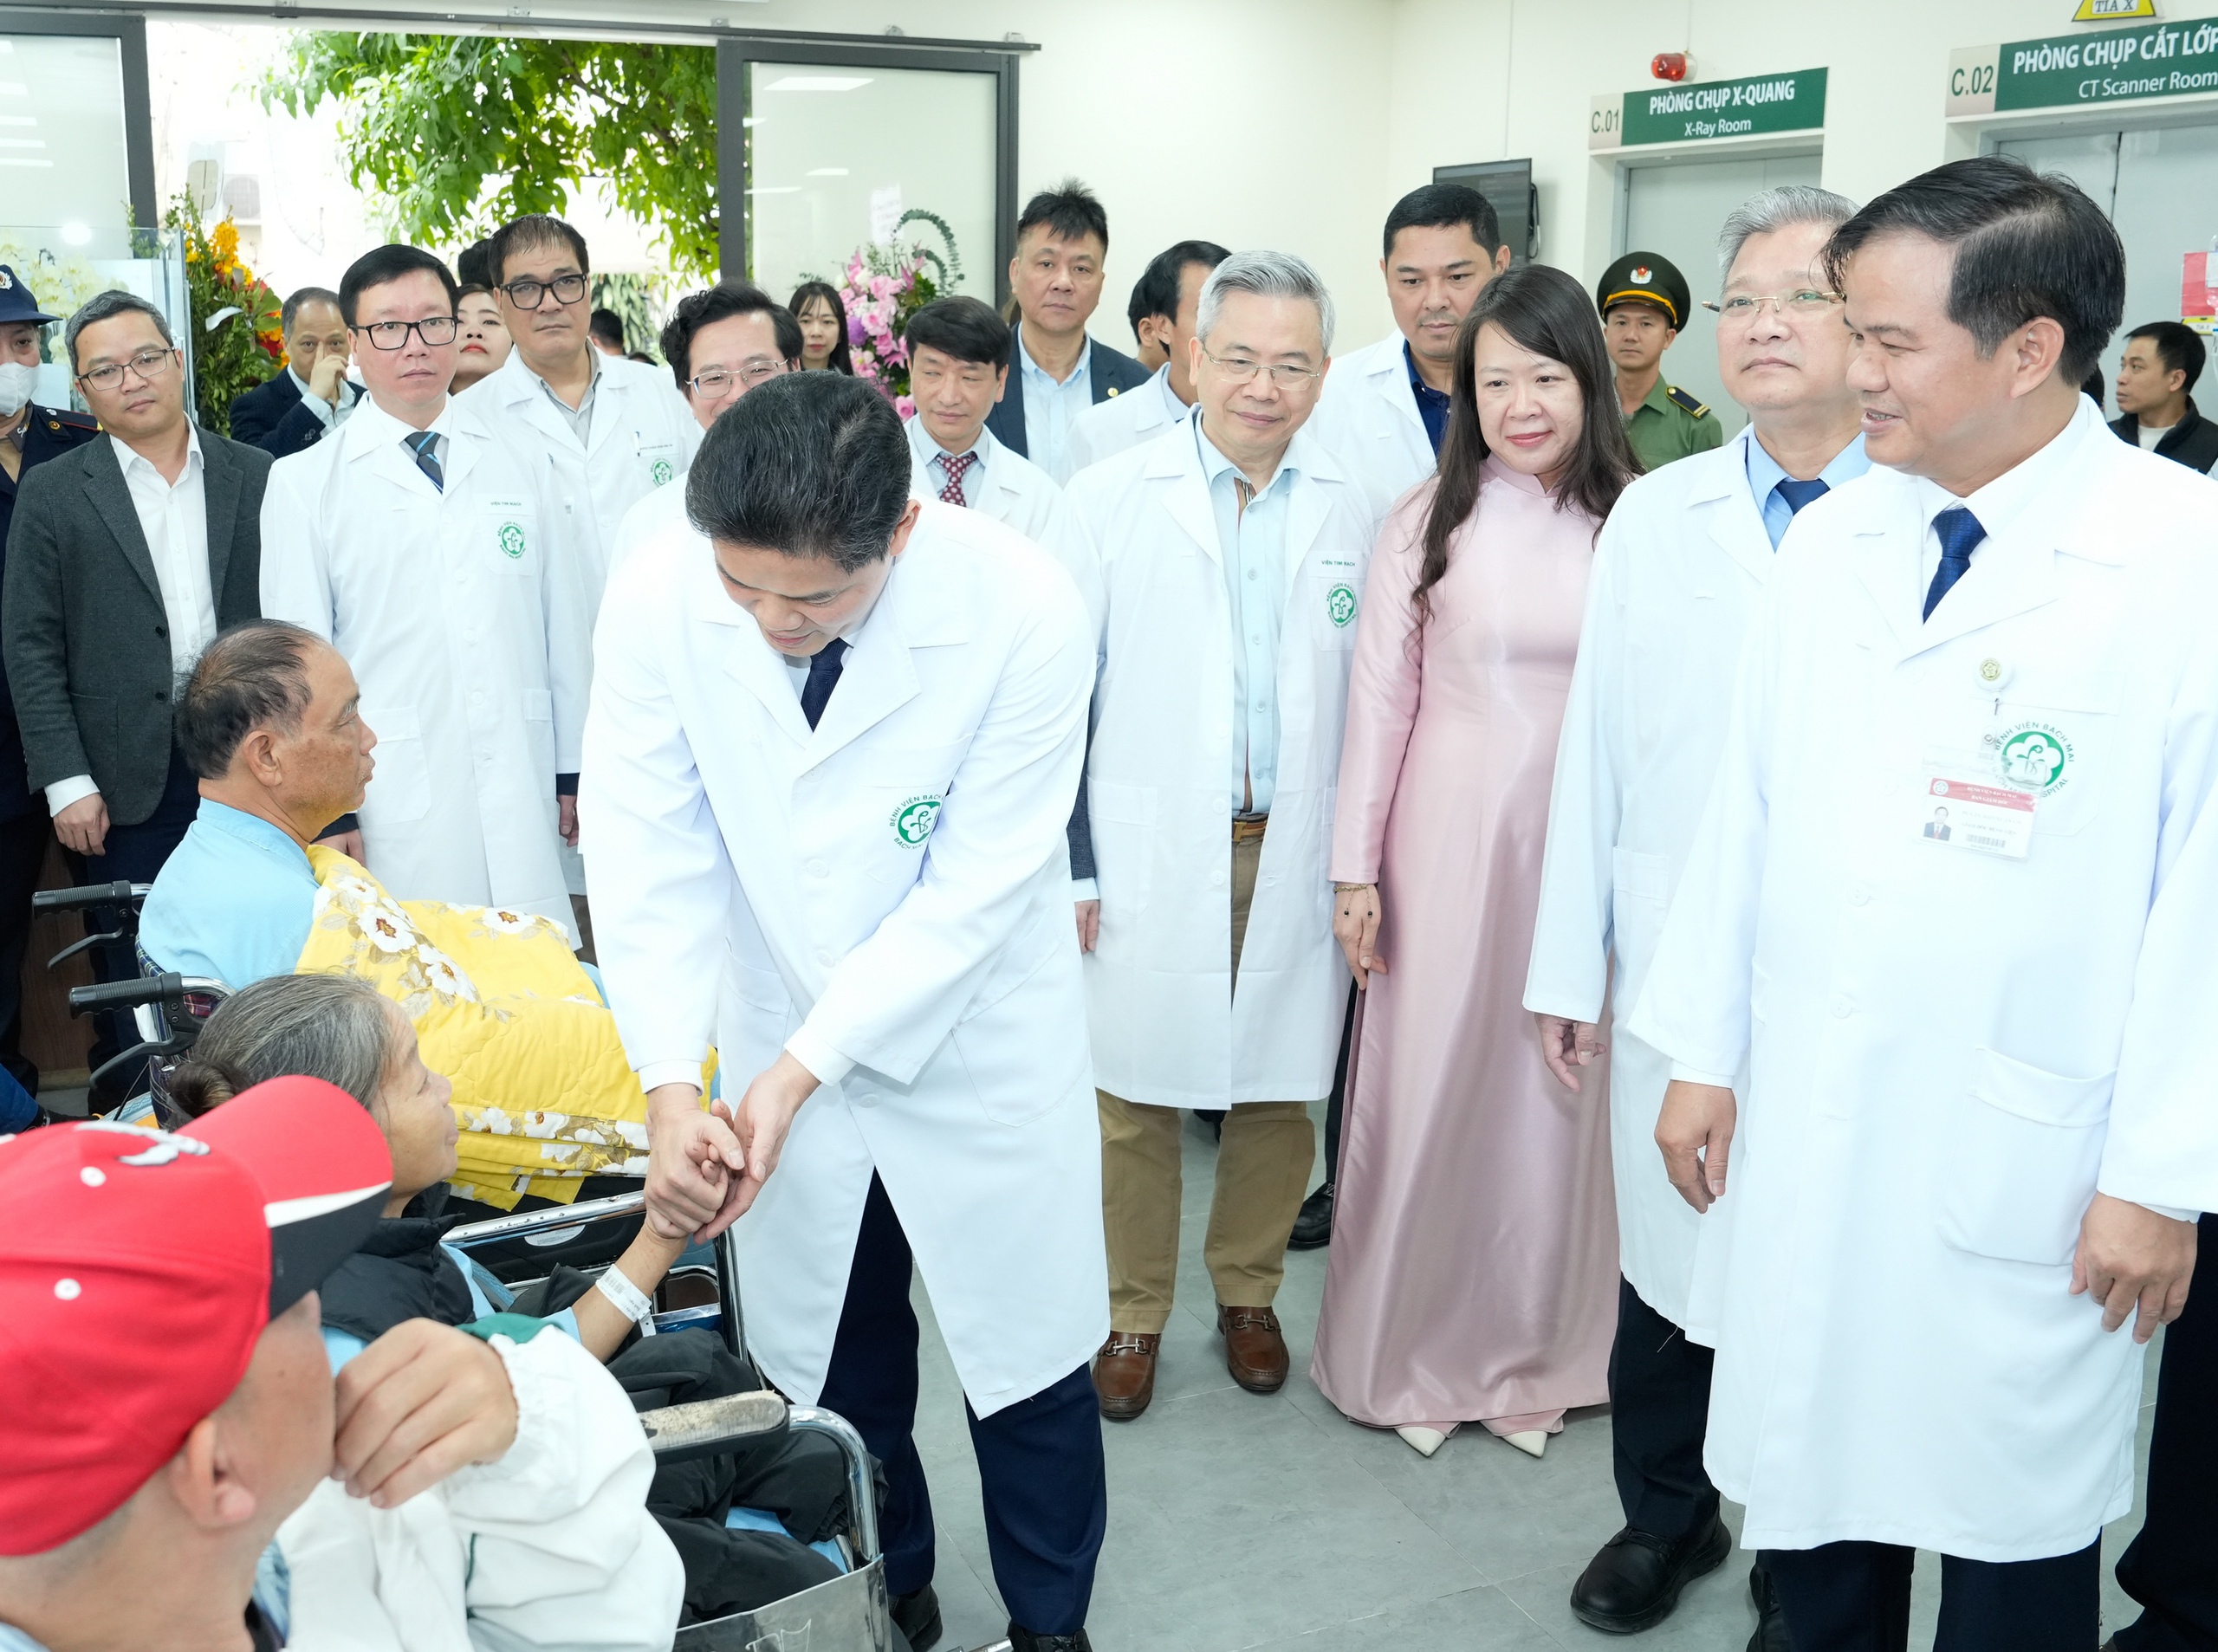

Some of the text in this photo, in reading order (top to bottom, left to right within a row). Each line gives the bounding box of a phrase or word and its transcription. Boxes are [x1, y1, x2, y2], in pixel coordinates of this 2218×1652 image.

[2095, 0, 2134, 13] TIA X
[2013, 23, 2218, 75] PHÒNG CHỤP CẮT LỚP
[1951, 65, 1994, 96] C.02
[2079, 71, 2218, 98] CT Scanner Room
[1649, 80, 1795, 115] PHÒNG CHỤP X-QUANG
[1592, 109, 1619, 133] C.01
[1684, 119, 1752, 138] X-Ray Room
[1995, 720, 2075, 762] BỆNH VIỆN BẠCH MAI
[2041, 778, 2069, 798] SPITAL
[901, 796, 920, 807] VIỆN
